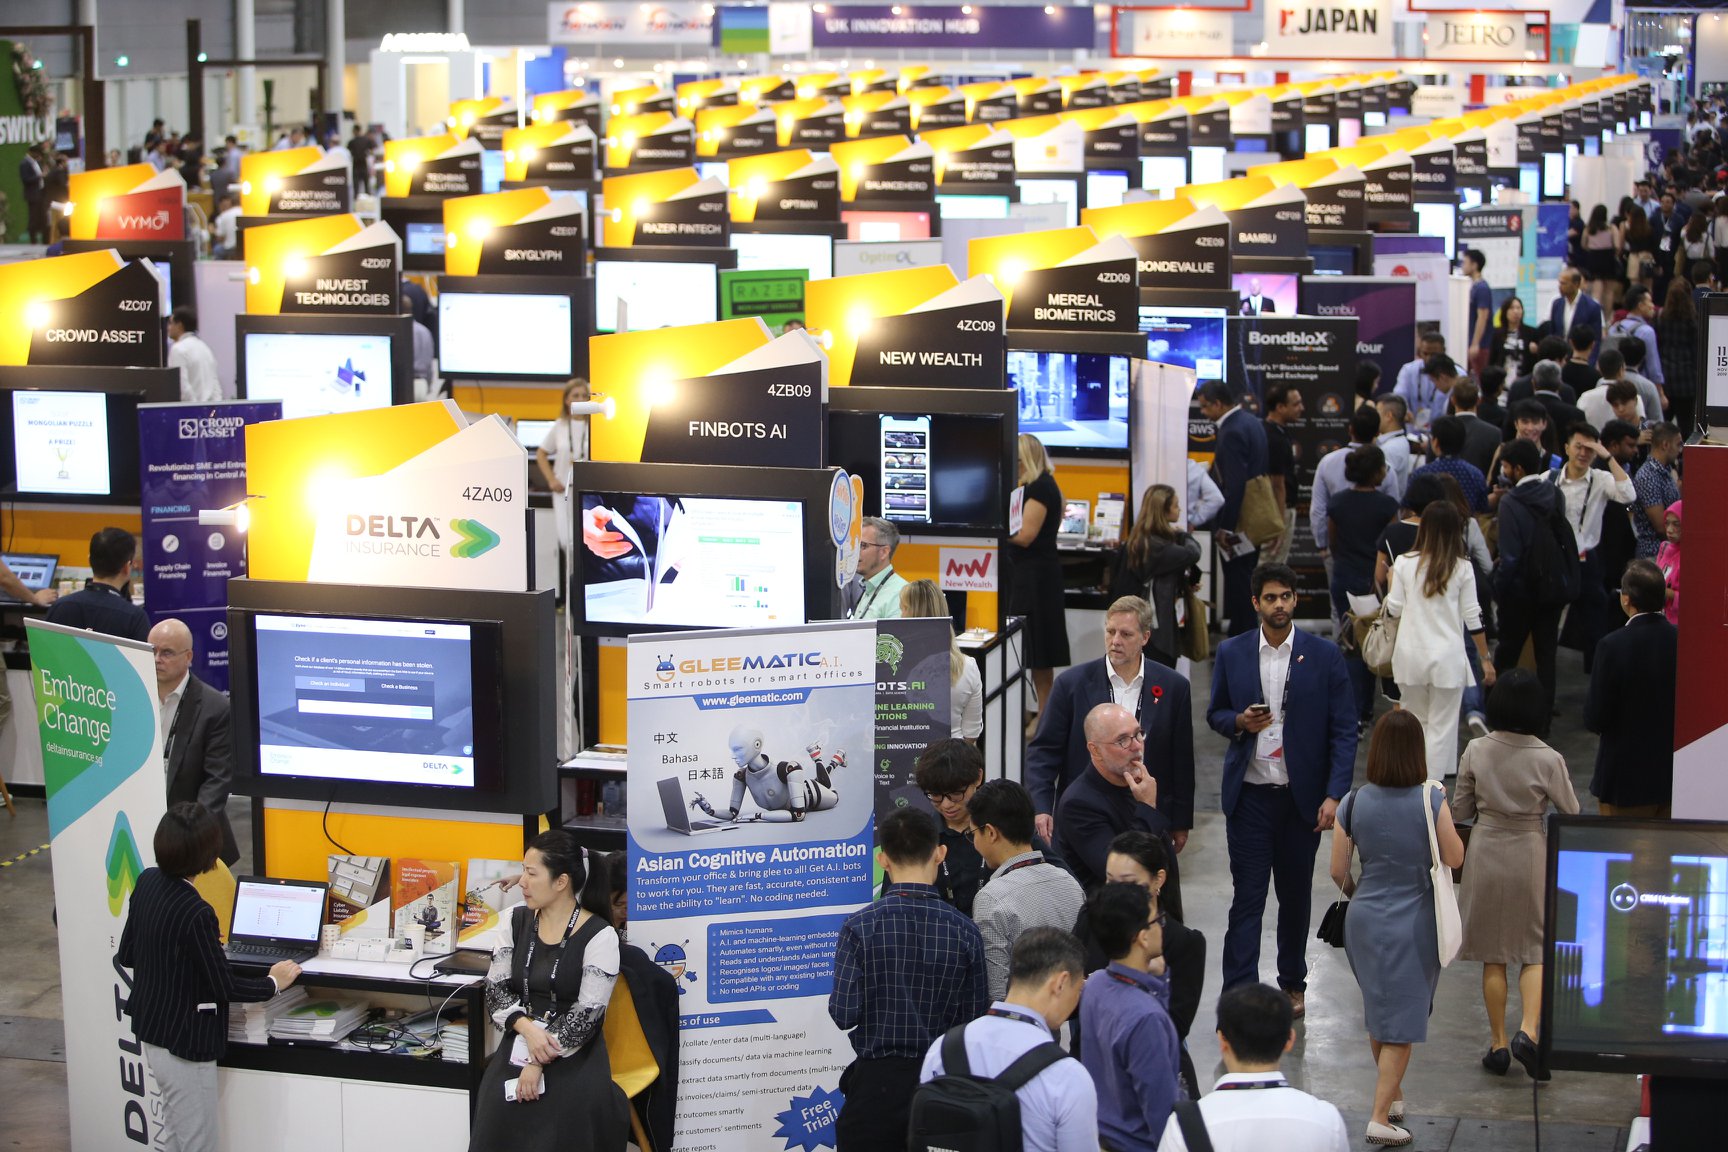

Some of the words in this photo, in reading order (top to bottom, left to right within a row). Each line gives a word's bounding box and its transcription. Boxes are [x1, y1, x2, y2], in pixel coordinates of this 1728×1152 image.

[825, 18, 849, 34] UK
[851, 18, 943, 34] INNOVATION
[945, 18, 981, 34] HUB
[1299, 8, 1377, 34] JAPAN
[1438, 21, 1515, 48] JETRO
[118, 214, 164, 231] VYMO
[1462, 215, 1508, 227] ARTEMIS
[642, 222, 677, 234] RAZER
[678, 223, 722, 235] FINTECH
[1195, 236, 1226, 248] 4ZE09
[1238, 232, 1278, 245] BAMBU
[504, 249, 563, 262] SKYGLYPH
[361, 258, 392, 269] 4ZD07
[1138, 260, 1216, 274] BONDEVALUE
[1097, 272, 1131, 284] 4ZD09
[316, 278, 369, 292] INUVEST
[295, 292, 390, 306] TECHNOLOGIES
[1048, 293, 1104, 308] MEREAL
[118, 300, 153, 312] 4ZC07
[1317, 303, 1355, 316] bambu
[1034, 307, 1117, 322] BIOMETRICS
[956, 320, 996, 332] 4ZC09
[46, 329, 99, 343] CROWD
[100, 329, 145, 344] ASSET
[1248, 331, 1329, 346] BondbloX
[879, 351, 916, 366] NEW
[919, 352, 983, 367] WEALTH
[1717, 356, 1728, 367] 15
[767, 383, 812, 398] 4ZB09
[199, 416, 245, 428] CROWD
[200, 427, 237, 438] ASSET
[688, 421, 767, 439] FINBOTS
[769, 423, 788, 439] AI
[1189, 423, 1216, 436] aws
[148, 462, 195, 472] Revolutionize
[196, 461, 212, 470] SME
[213, 461, 226, 470] and
[172, 472, 206, 482] financing
[214, 471, 239, 480] Central
[462, 486, 513, 502] 4ZA09
[151, 504, 191, 514] FINANCING
[346, 514, 440, 540] DELTA
[345, 541, 441, 558] INSURANCE
[154, 565, 174, 573] Supply
[174, 563, 192, 571] Chain
[206, 561, 228, 569] Invoice
[158, 572, 187, 580] Financing
[203, 569, 232, 578] Financing
[945, 580, 963, 588] New
[964, 579, 993, 589] Wealth
[361, 659, 392, 667] information
[679, 652, 822, 674] GLEEMATIC
[644, 681, 683, 690] Smart
[691, 678, 735, 687] robots
[770, 673, 807, 682] smart
[815, 670, 863, 679] offices
[41, 668, 117, 711] Embrace
[702, 691, 803, 706] www.gleematic.com
[891, 703, 935, 711] LEARNING
[44, 702, 111, 747] Change
[653, 732, 679, 744] 中文
[46, 742, 103, 767] deltainsurance.sg
[662, 753, 699, 765] Bahasa
[423, 762, 448, 770] DELTA
[688, 767, 724, 781] 日本語
[636, 856, 684, 872] Asian
[689, 849, 766, 870] Cognitive
[770, 842, 867, 863] Automation
[636, 875, 680, 886] Transform
[682, 874, 702, 884] your
[703, 871, 727, 881] office
[738, 869, 762, 879] bring
[763, 868, 782, 879] glee
[783, 868, 793, 876] to
[794, 865, 808, 874] all!
[809, 864, 824, 873] Get
[843, 862, 862, 871] bots
[636, 891, 646, 899] to
[648, 889, 670, 898] work
[672, 887, 684, 896] for
[686, 887, 705, 897] you.
[706, 884, 728, 894] They
[729, 883, 744, 892] are
[745, 881, 764, 891] fast,
[766, 879, 805, 890] accurate,
[806, 875, 850, 886] consistent
[851, 873, 867, 883] and
[636, 903, 658, 911] have
[659, 901, 674, 910] the
[676, 899, 702, 909] ability
[704, 898, 714, 906] to
[750, 894, 763, 902] No
[764, 892, 794, 903] coding
[795, 889, 829, 900] needed.
[745, 927, 774, 935] humans
[747, 933, 806, 945] machine-learning
[719, 947, 757, 957] Automates
[758, 953, 801, 963] understands
[689, 1016, 701, 1026] of
[702, 1016, 721, 1025] use
[733, 1035, 749, 1044] data
[750, 1031, 807, 1044] (multi-language)
[745, 1052, 761, 1061] data
[773, 1050, 804, 1059] machine
[804, 1047, 832, 1056] learning
[681, 1075, 706, 1085] extract
[707, 1074, 723, 1083] data
[724, 1072, 750, 1082] smartly
[751, 1070, 768, 1079] from
[769, 1067, 808, 1078] documents
[741, 1085, 796, 1097] semi-structured
[796, 1083, 813, 1092] data
[683, 1110, 717, 1119] outcomes
[718, 1107, 745, 1117] smartly
[800, 1099, 832, 1121] Free
[802, 1107, 839, 1134] Trial!
[724, 1123, 763, 1132] sentiments
